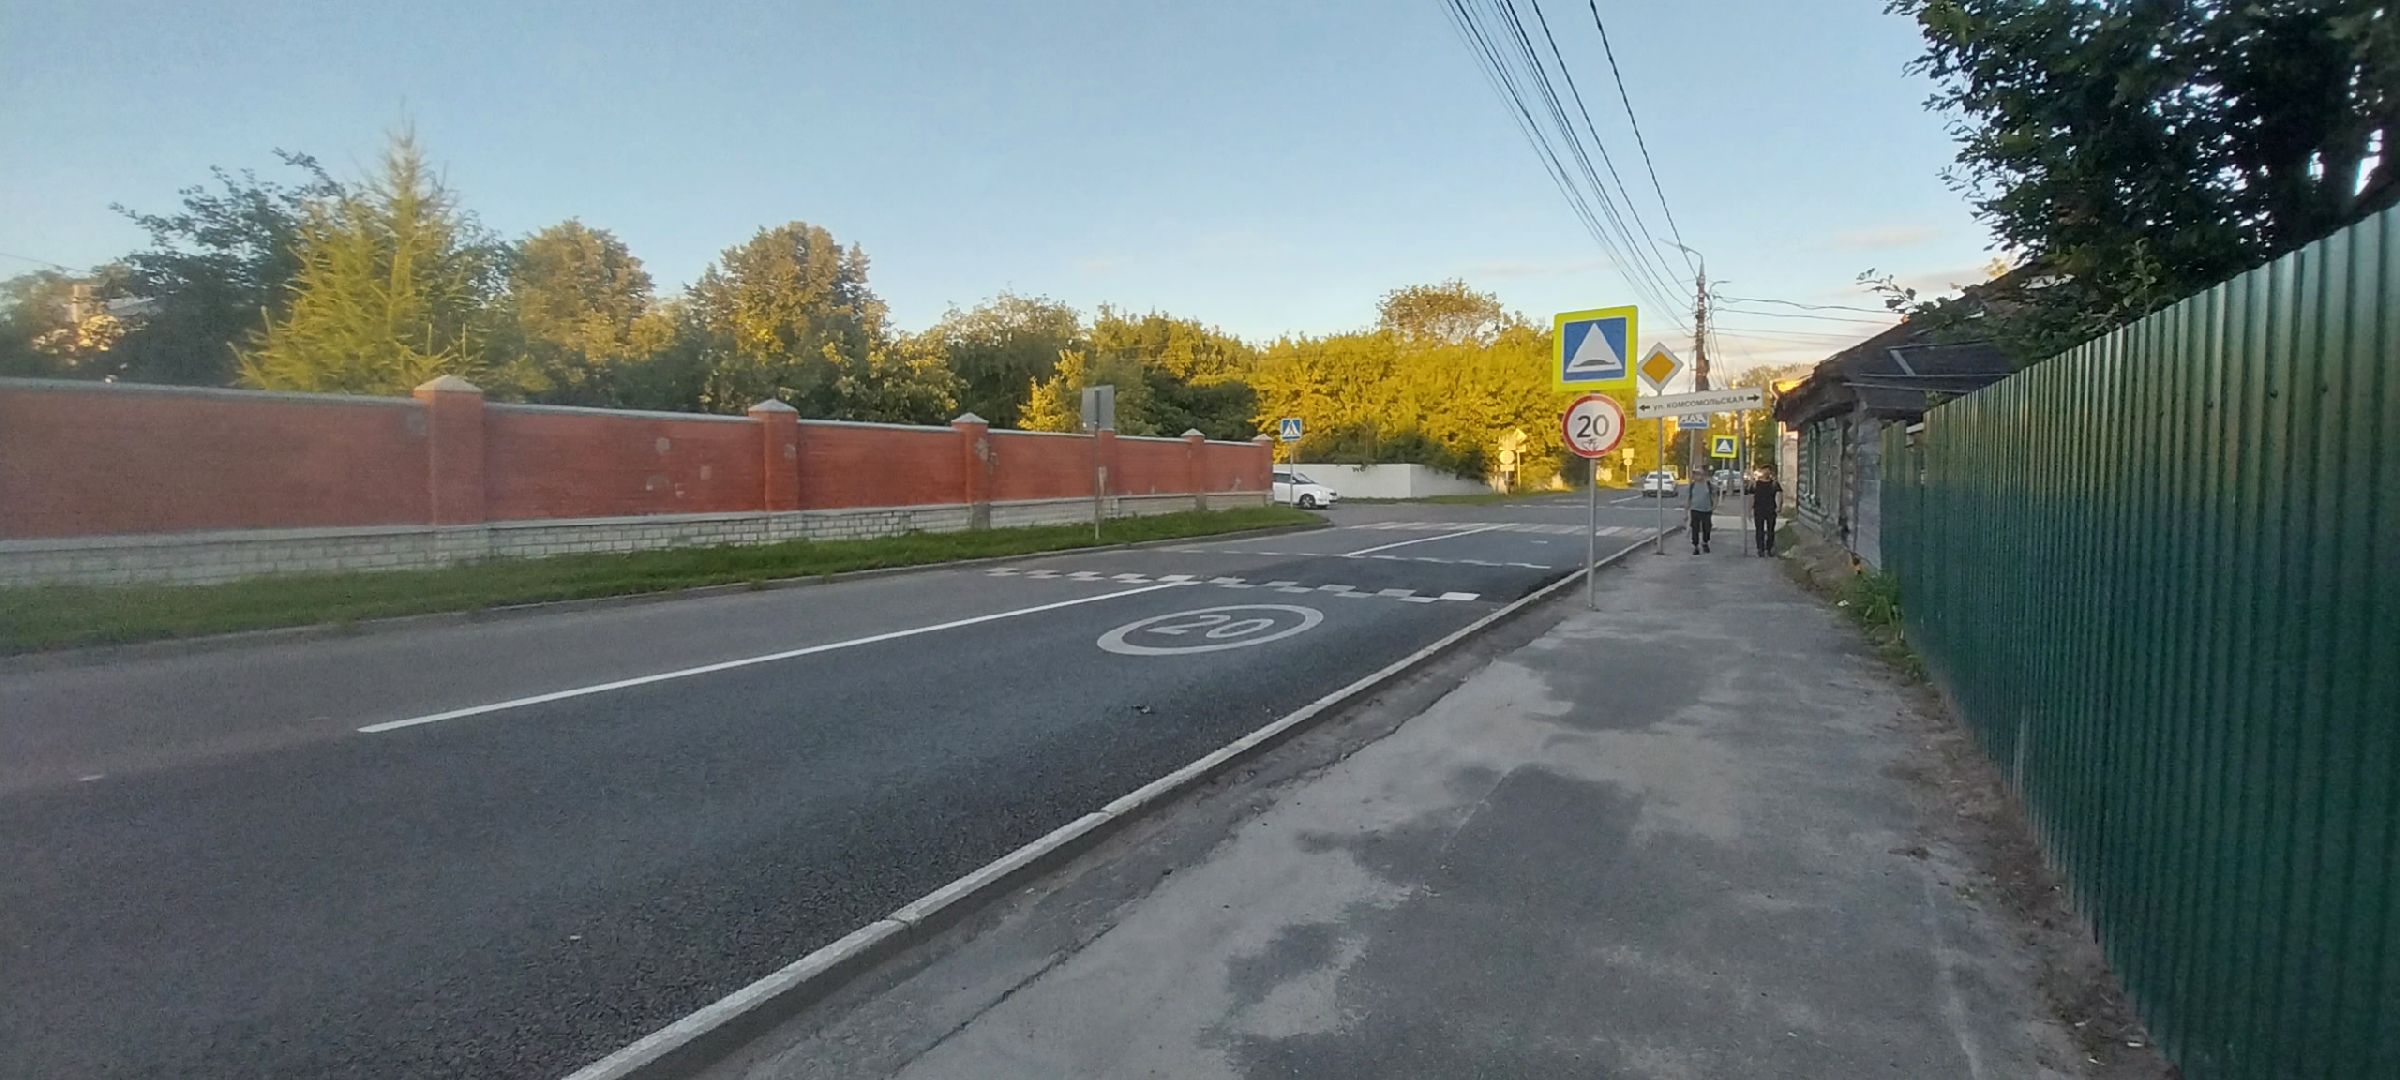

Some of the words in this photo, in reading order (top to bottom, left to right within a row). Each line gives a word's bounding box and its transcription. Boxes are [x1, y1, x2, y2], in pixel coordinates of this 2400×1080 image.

[1666, 395, 1745, 409] КОМСОМОЛЬСКАЯ
[1576, 414, 1610, 438] 20
[1146, 614, 1275, 639] 20
